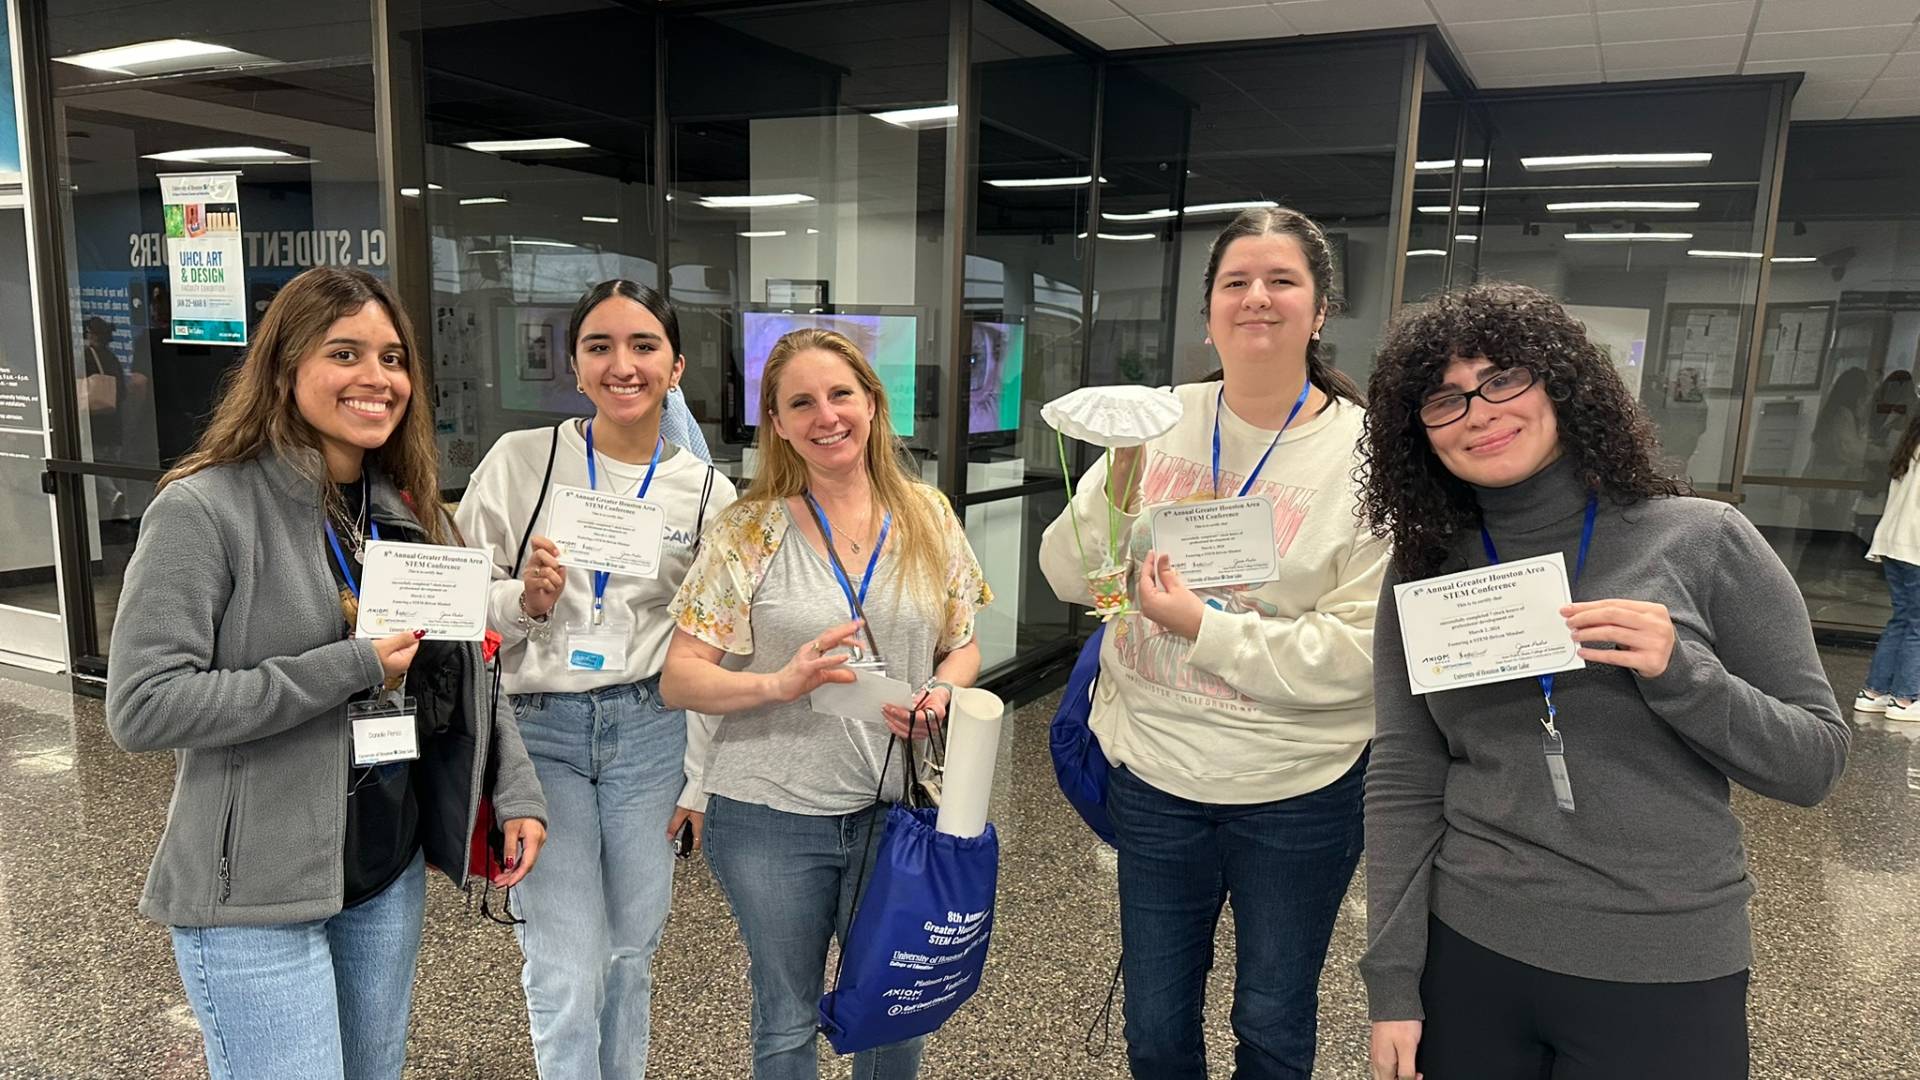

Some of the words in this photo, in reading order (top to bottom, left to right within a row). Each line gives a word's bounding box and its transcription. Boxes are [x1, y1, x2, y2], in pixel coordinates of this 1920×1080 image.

[179, 251, 204, 266] UHCL
[206, 251, 222, 266] ART
[181, 268, 188, 283] &
[191, 268, 224, 283] DESIGN
[575, 493, 596, 501] Annual
[596, 496, 618, 505] Greater
[619, 500, 641, 508] Houston
[643, 504, 656, 512] Area
[604, 505, 635, 515] Conference
[1173, 509, 1194, 517] Annual
[1195, 506, 1218, 514] Greater
[1205, 512, 1239, 520] Conference
[417, 553, 440, 561] Greater
[442, 555, 468, 563] Houston
[426, 562, 461, 570] Conference
[1426, 583, 1455, 595] Annual
[1456, 576, 1487, 588] Greater
[1488, 570, 1523, 582] Houston
[1525, 566, 1545, 575] Area
[1443, 589, 1469, 600] STEM
[1471, 581, 1517, 595] Conference
[947, 911, 962, 923] 8th
[923, 921, 957, 935] Greater
[928, 934, 951, 945] STEM
[893, 950, 929, 963] University
[929, 955, 939, 964] of
[882, 988, 924, 997] AXIOM
